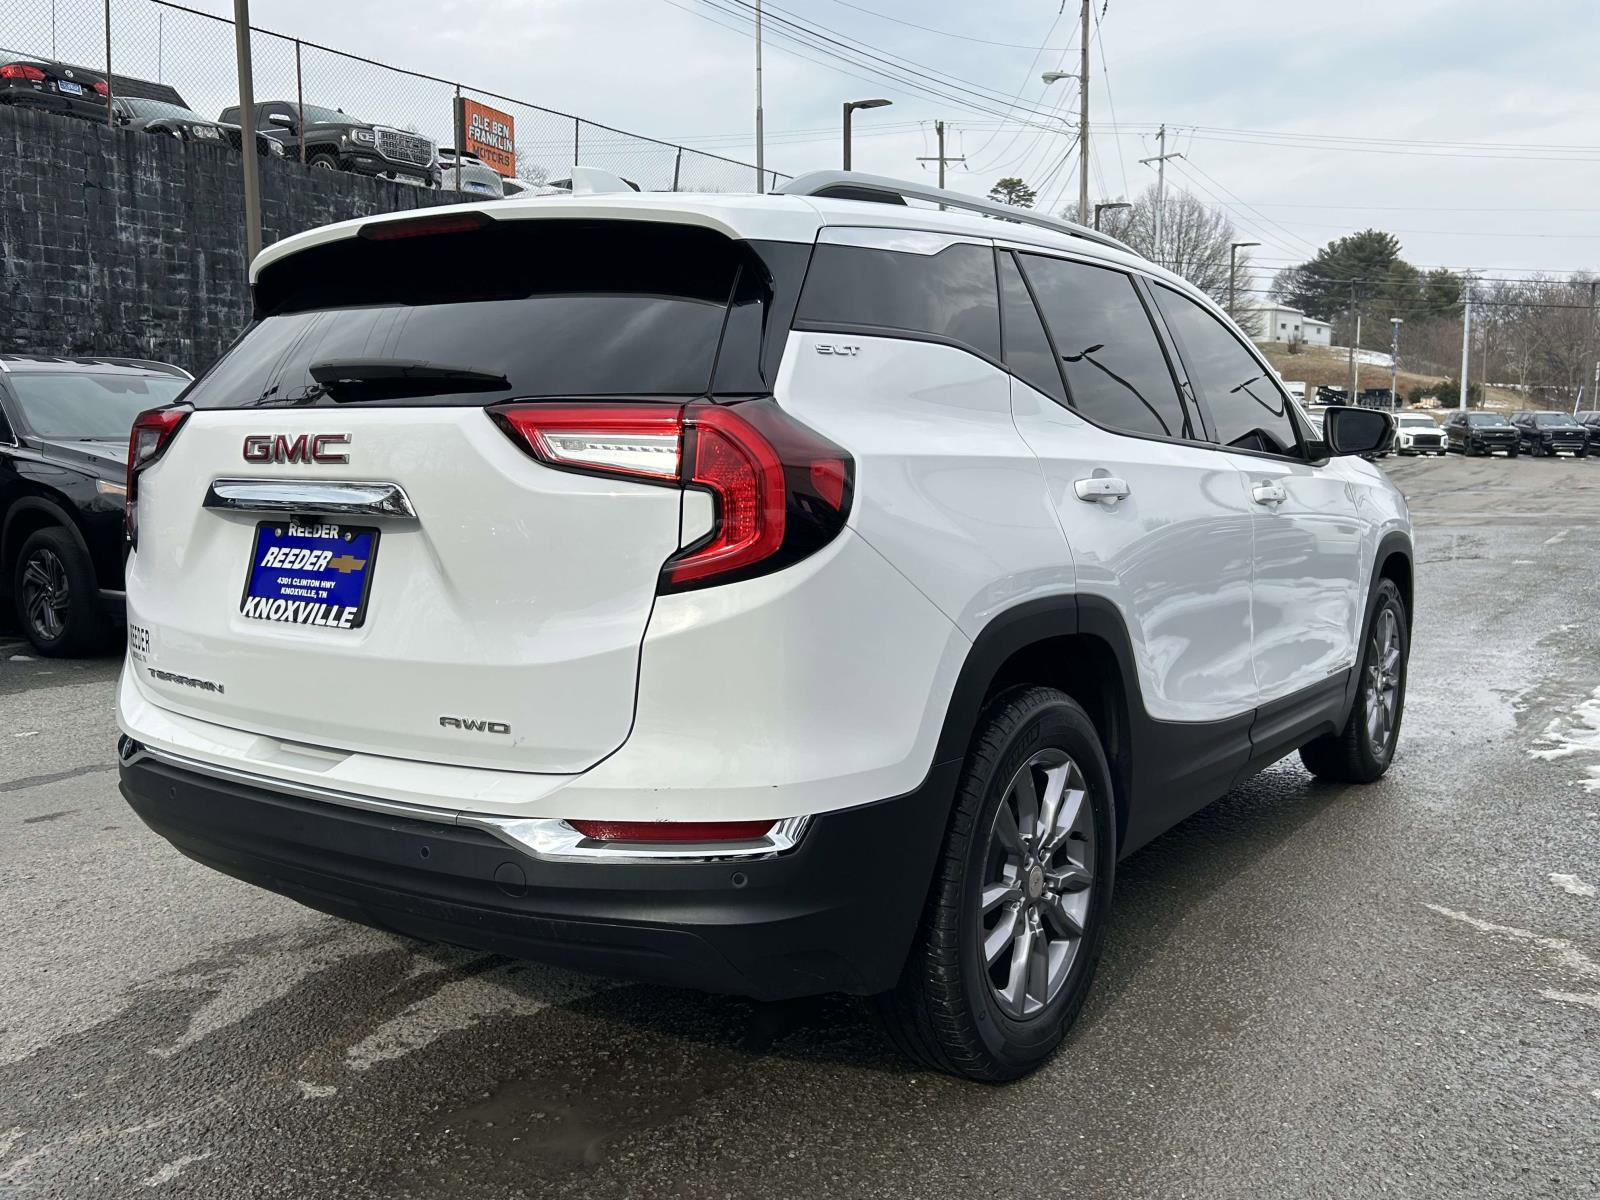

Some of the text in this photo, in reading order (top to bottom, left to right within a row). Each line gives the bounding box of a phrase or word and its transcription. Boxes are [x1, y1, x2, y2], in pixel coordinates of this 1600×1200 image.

[472, 113, 509, 139] OLE BEN
[468, 125, 513, 153] FRANKLIN
[473, 144, 510, 167] MOTORS
[815, 344, 860, 356] SLT
[243, 433, 352, 465] GMC
[288, 522, 339, 540] REEDER
[260, 546, 333, 572] REEDER
[277, 576, 336, 589] 4301 CLINTON HWY
[280, 587, 328, 599] KNOXVILLE, TN
[241, 596, 358, 629] KNOXVILLE
[147, 667, 224, 695] TERRAIN
[439, 716, 511, 735] AWD
